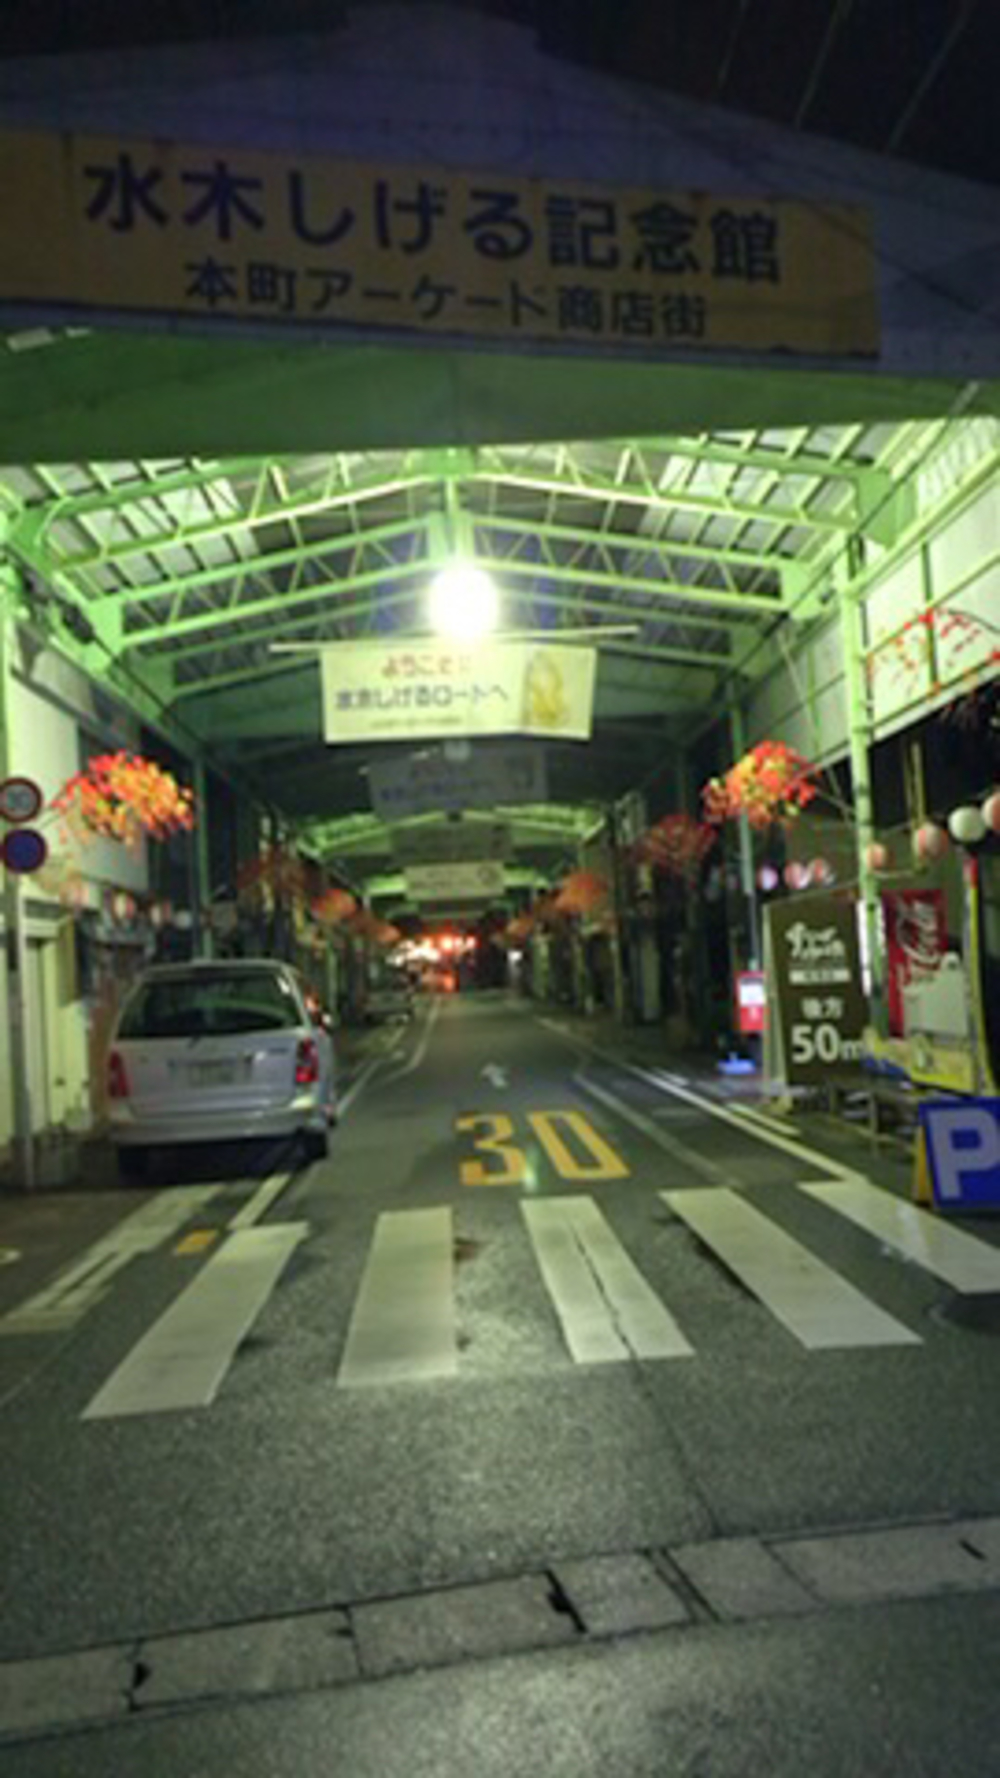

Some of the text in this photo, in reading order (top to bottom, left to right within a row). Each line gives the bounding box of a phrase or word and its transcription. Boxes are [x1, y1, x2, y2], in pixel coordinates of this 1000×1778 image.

[83, 153, 782, 285] 水木しげる記念館
[184, 256, 707, 338] 本町アーケード商店街
[381, 654, 471, 679] ようこそ
[456, 1110, 631, 1186] 30
[928, 1106, 1000, 1200] P
